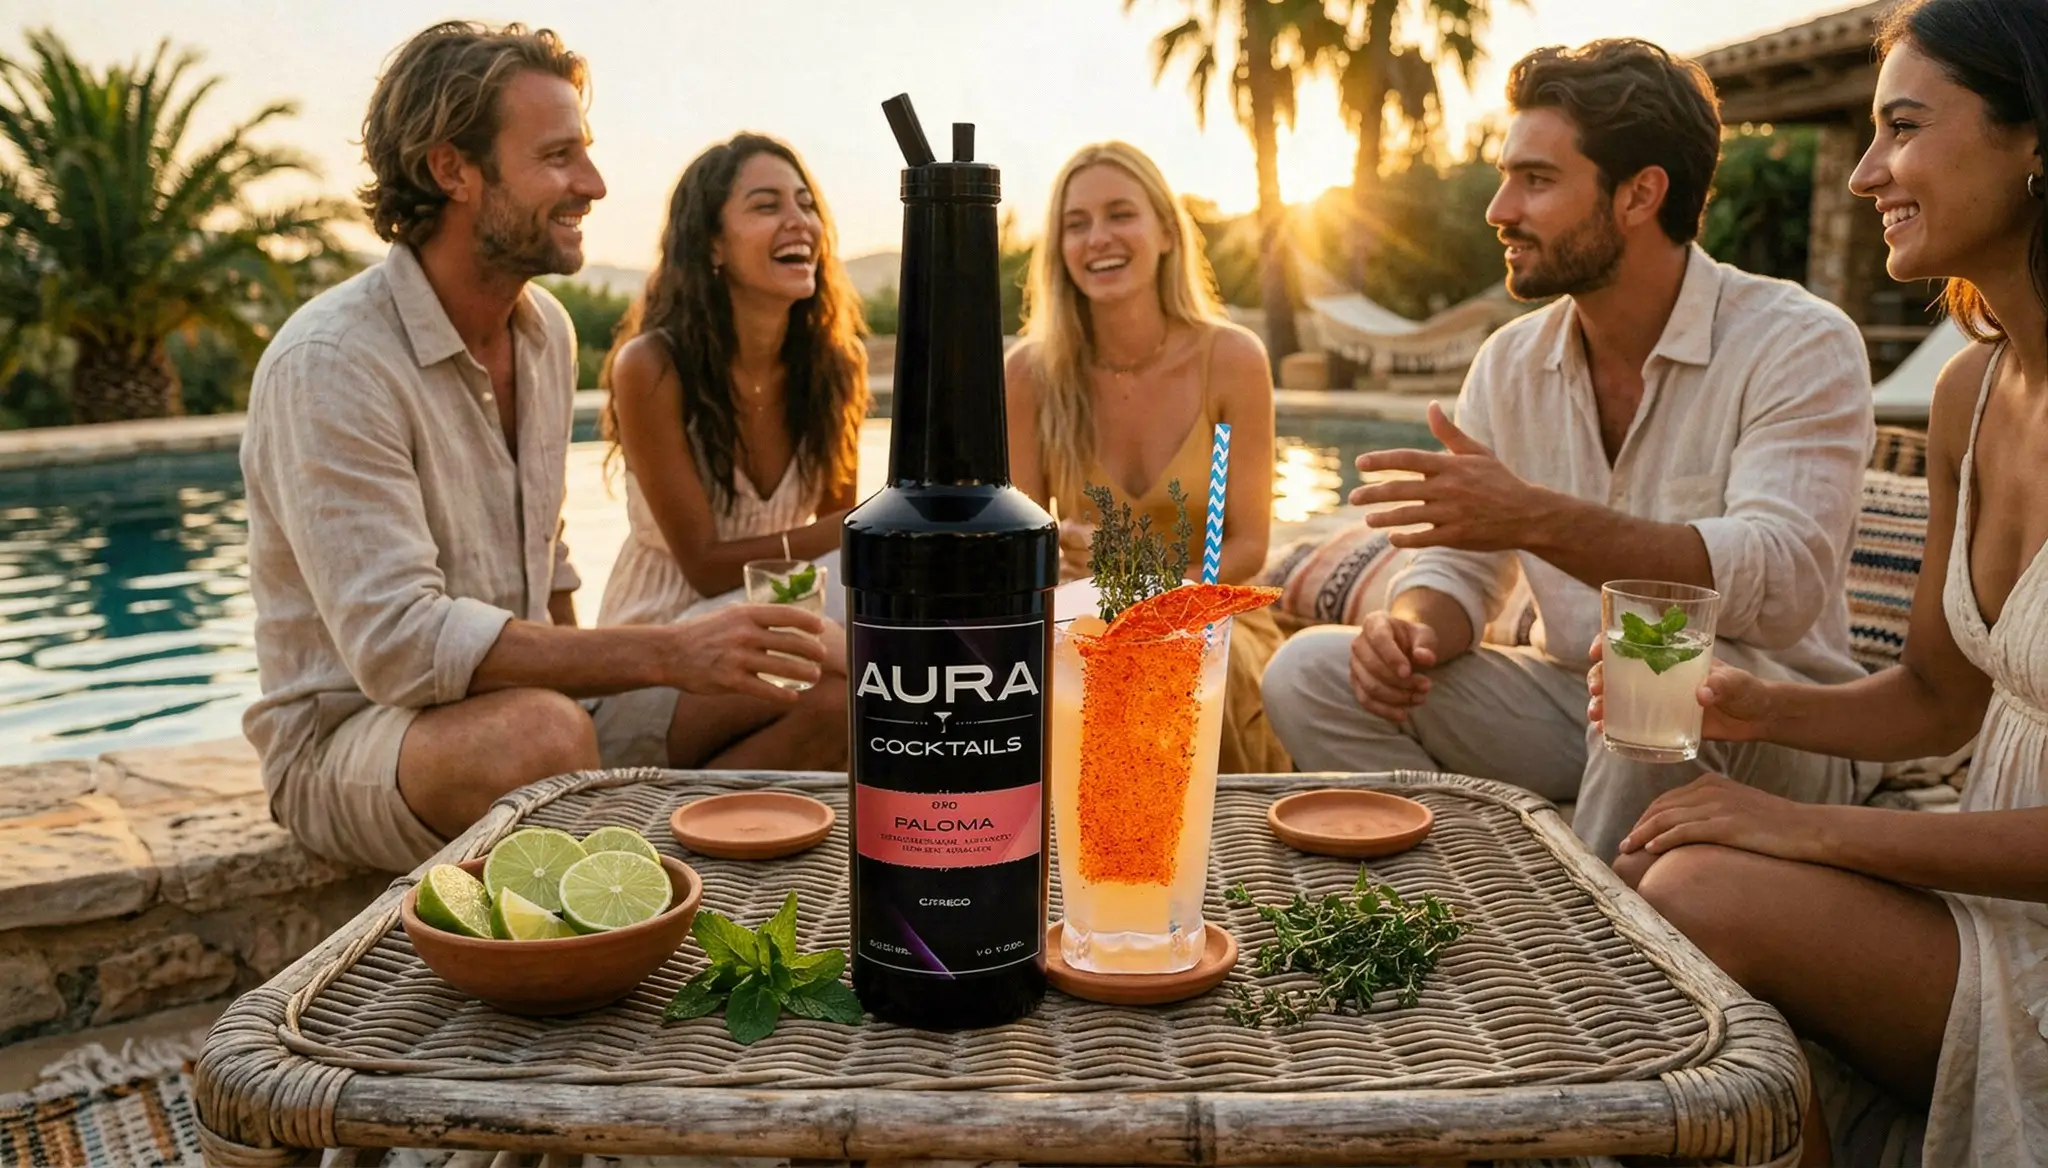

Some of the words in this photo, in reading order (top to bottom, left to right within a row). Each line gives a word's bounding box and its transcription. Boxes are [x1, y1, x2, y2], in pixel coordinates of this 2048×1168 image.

[857, 661, 1039, 704] AURA
[870, 736, 1022, 756] COCKTAILS
[895, 816, 995, 832] PALOMA
